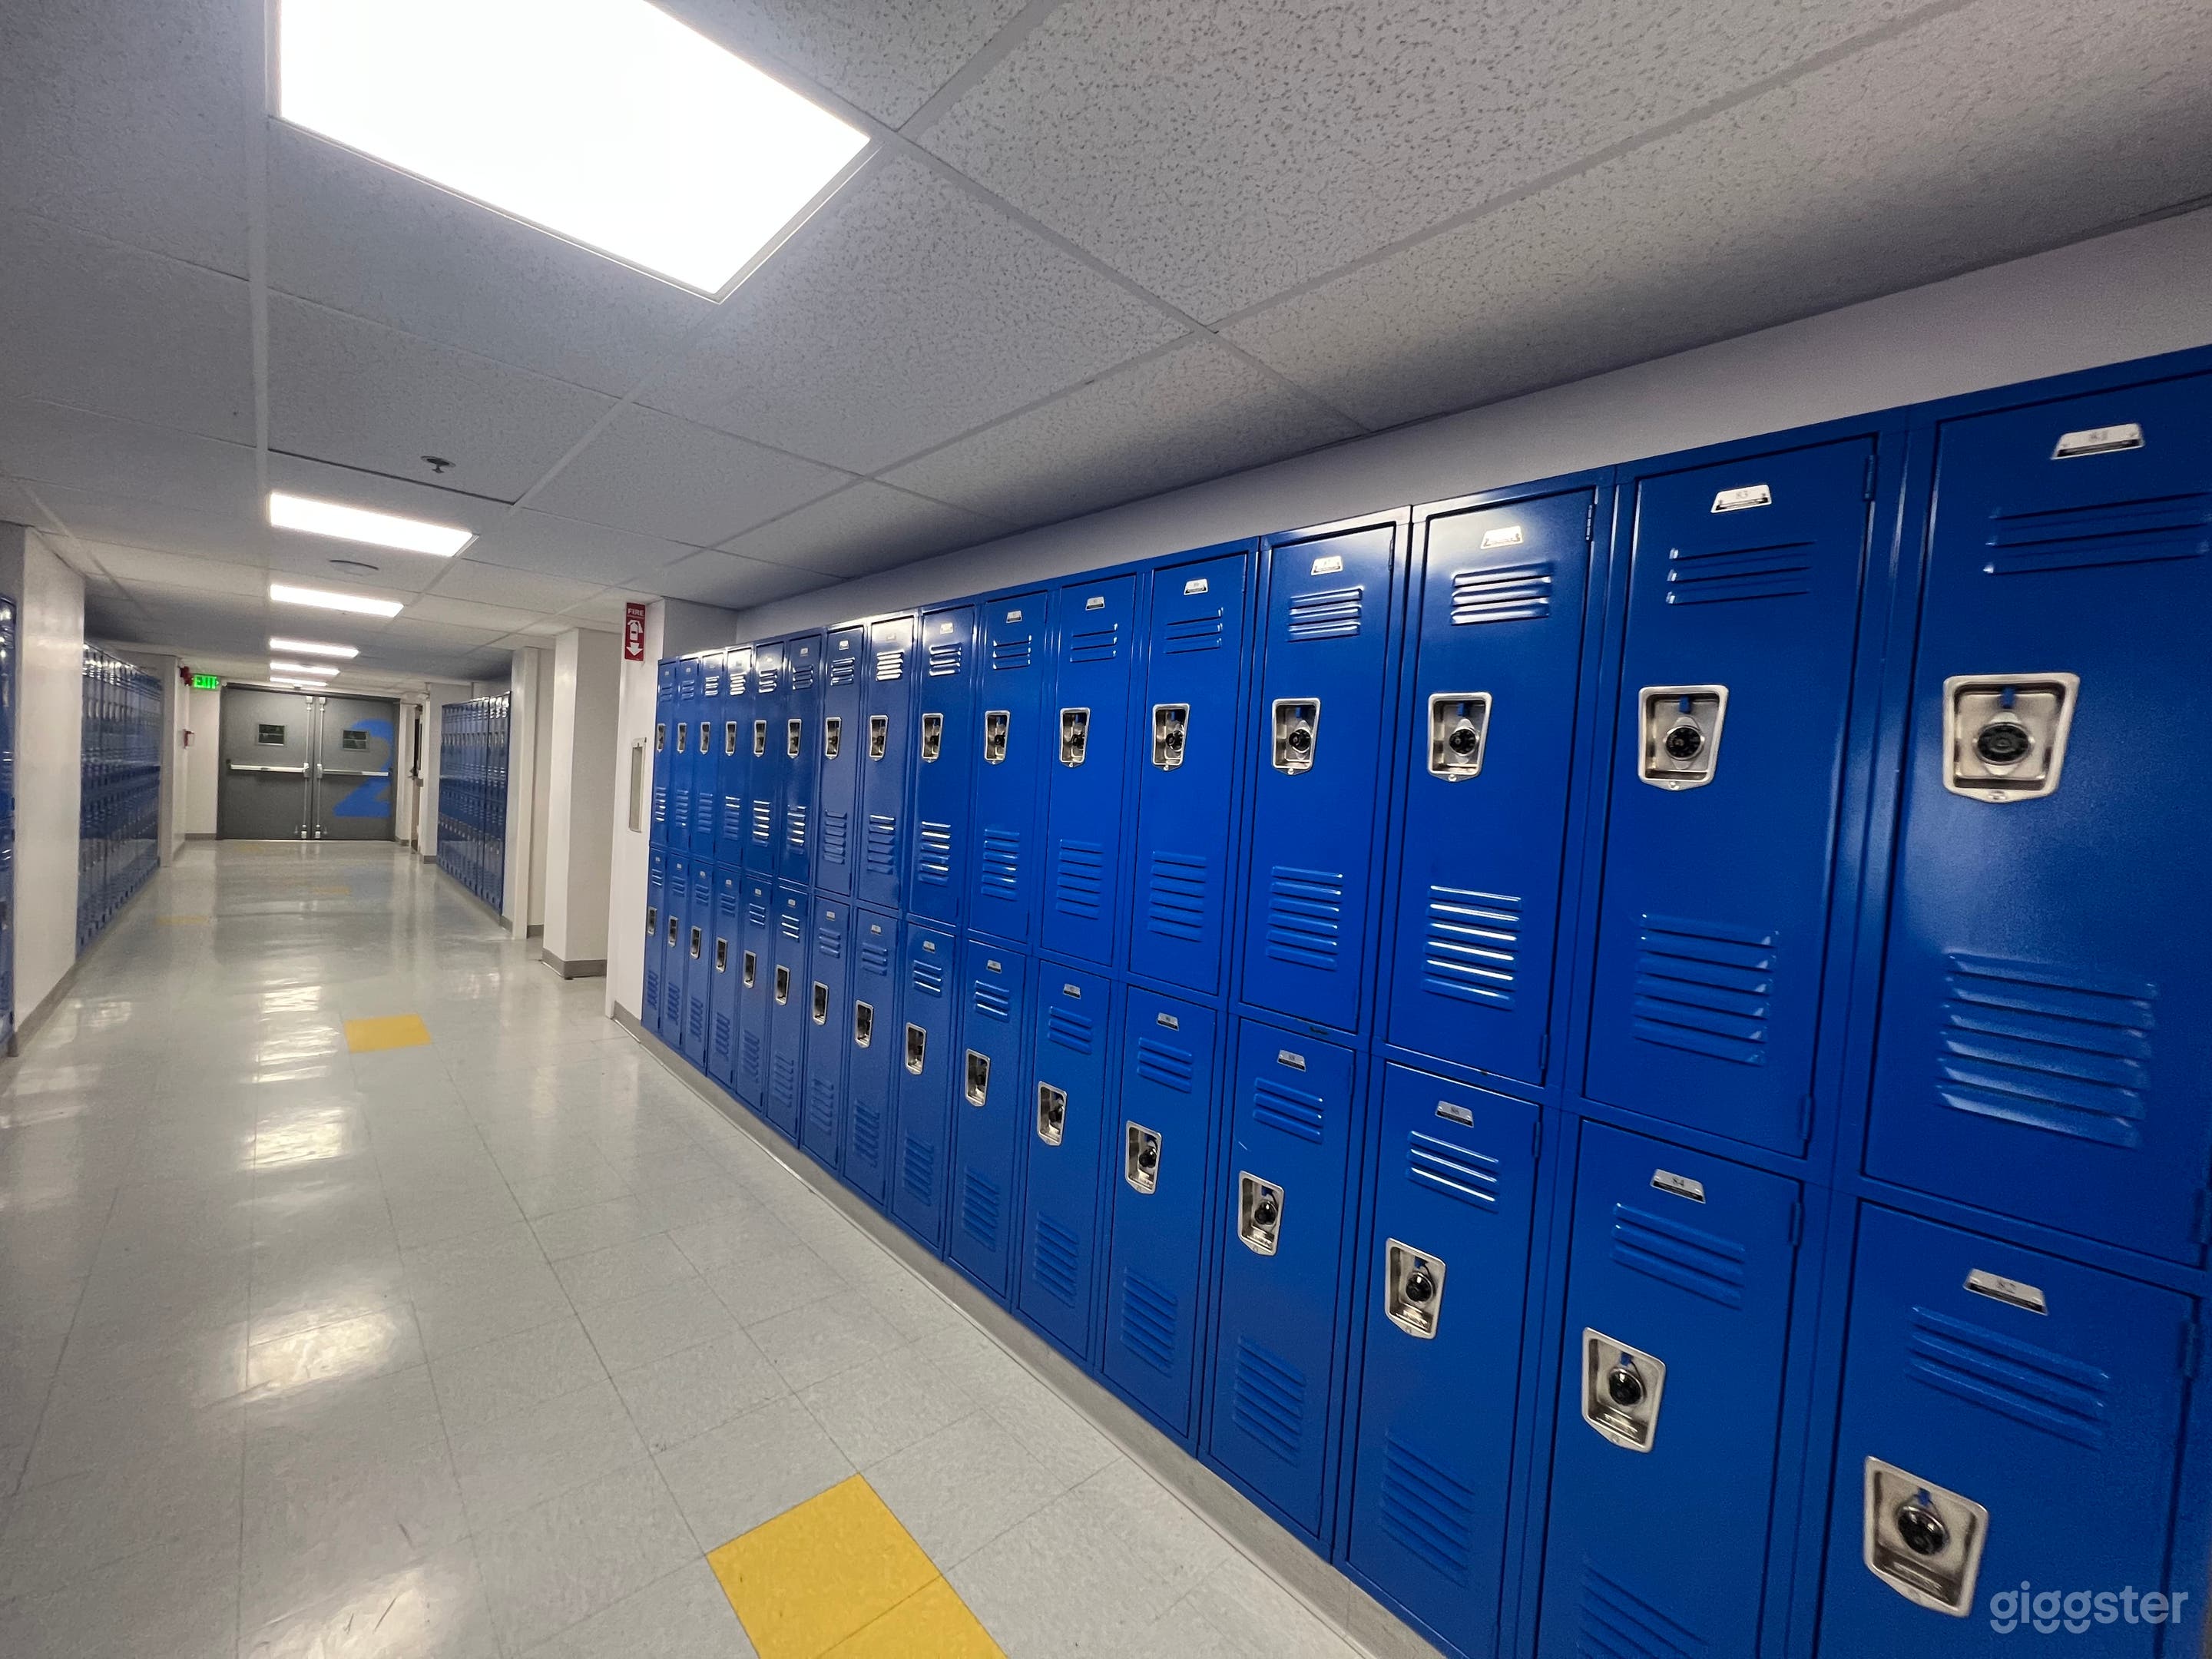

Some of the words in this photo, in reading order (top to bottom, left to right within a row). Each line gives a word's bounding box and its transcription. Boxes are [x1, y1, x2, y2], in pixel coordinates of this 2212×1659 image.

[628, 608, 644, 617] FIRE
[194, 675, 217, 689] EXIT
[332, 718, 393, 818] 2
